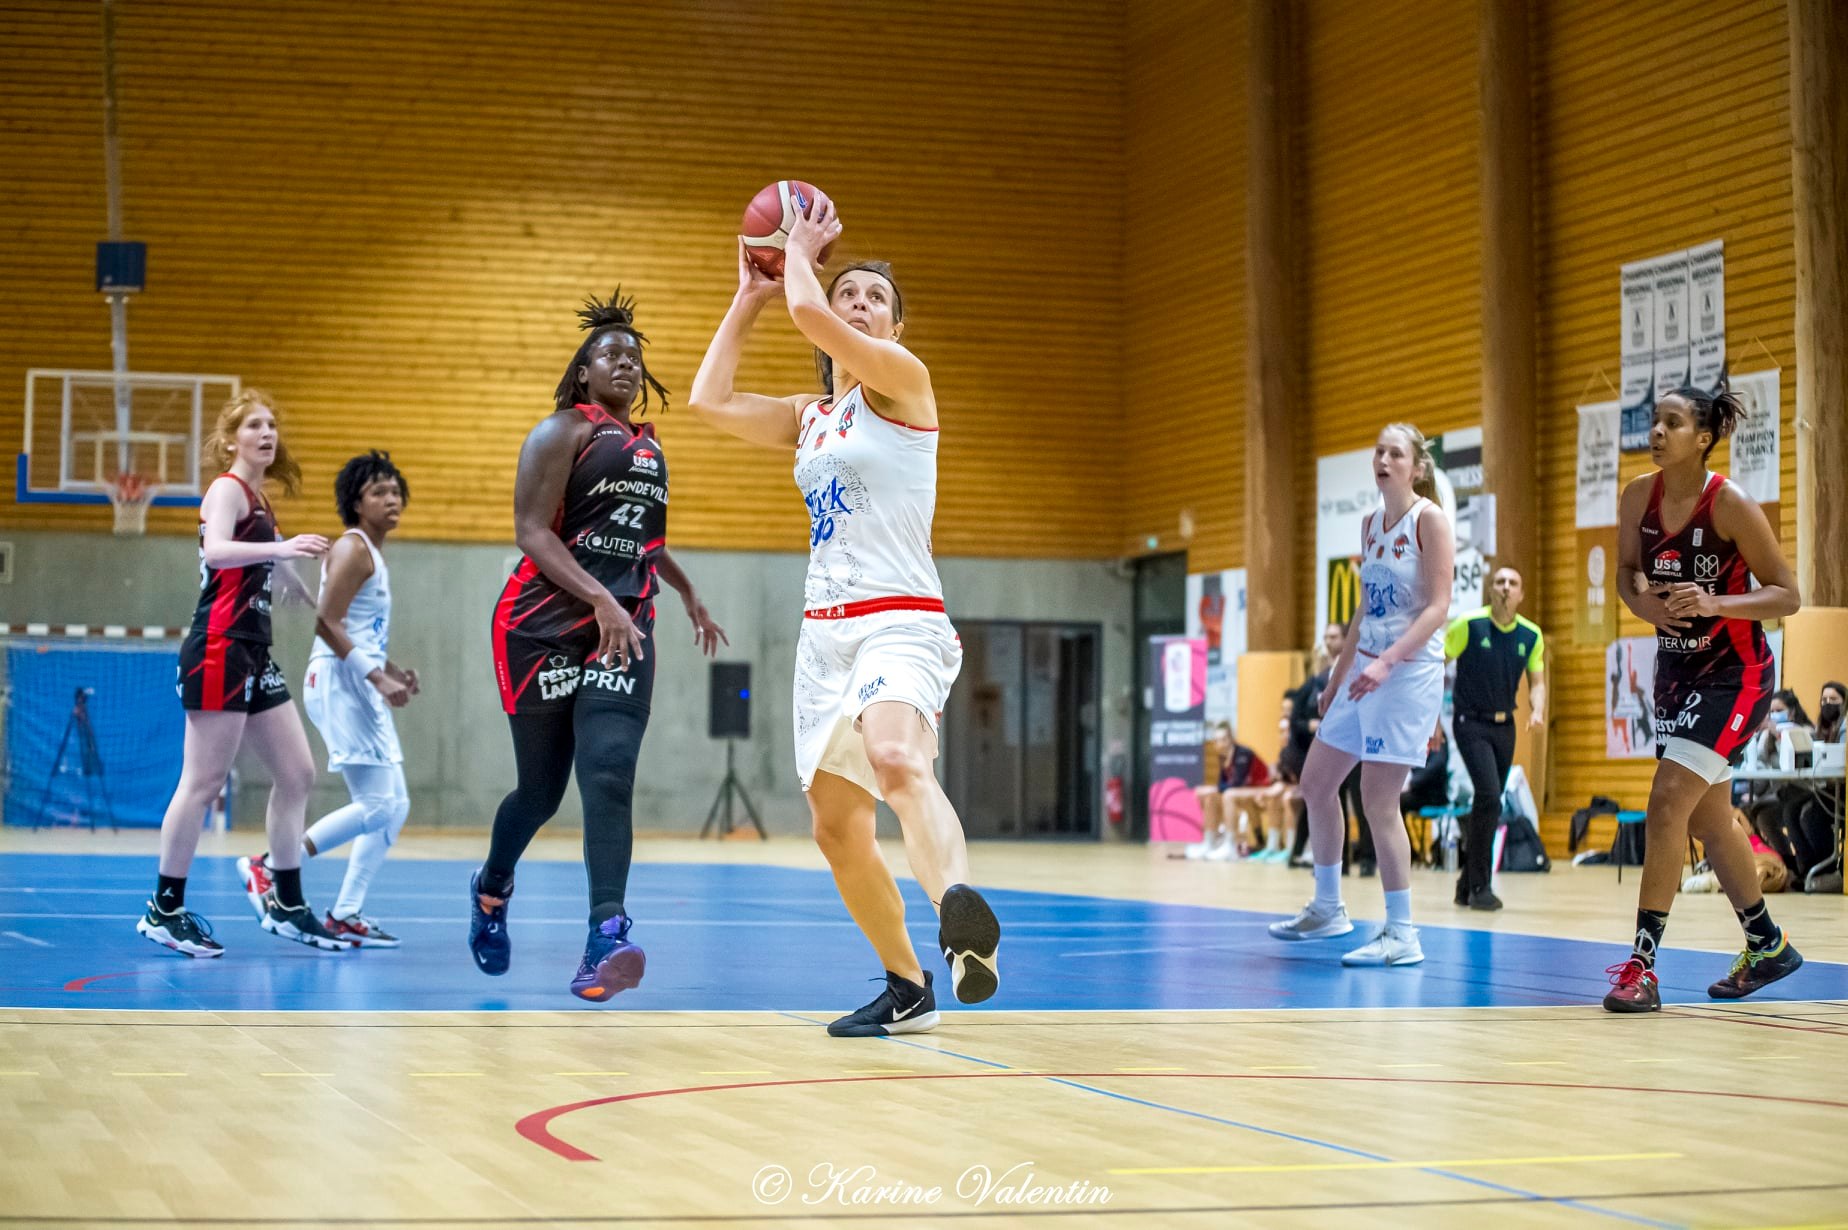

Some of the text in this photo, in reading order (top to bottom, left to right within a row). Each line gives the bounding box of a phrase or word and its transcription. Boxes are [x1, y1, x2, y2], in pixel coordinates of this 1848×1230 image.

[586, 477, 668, 505] MONDEVILL
[610, 503, 646, 529] 42
[582, 669, 636, 695] PRN
